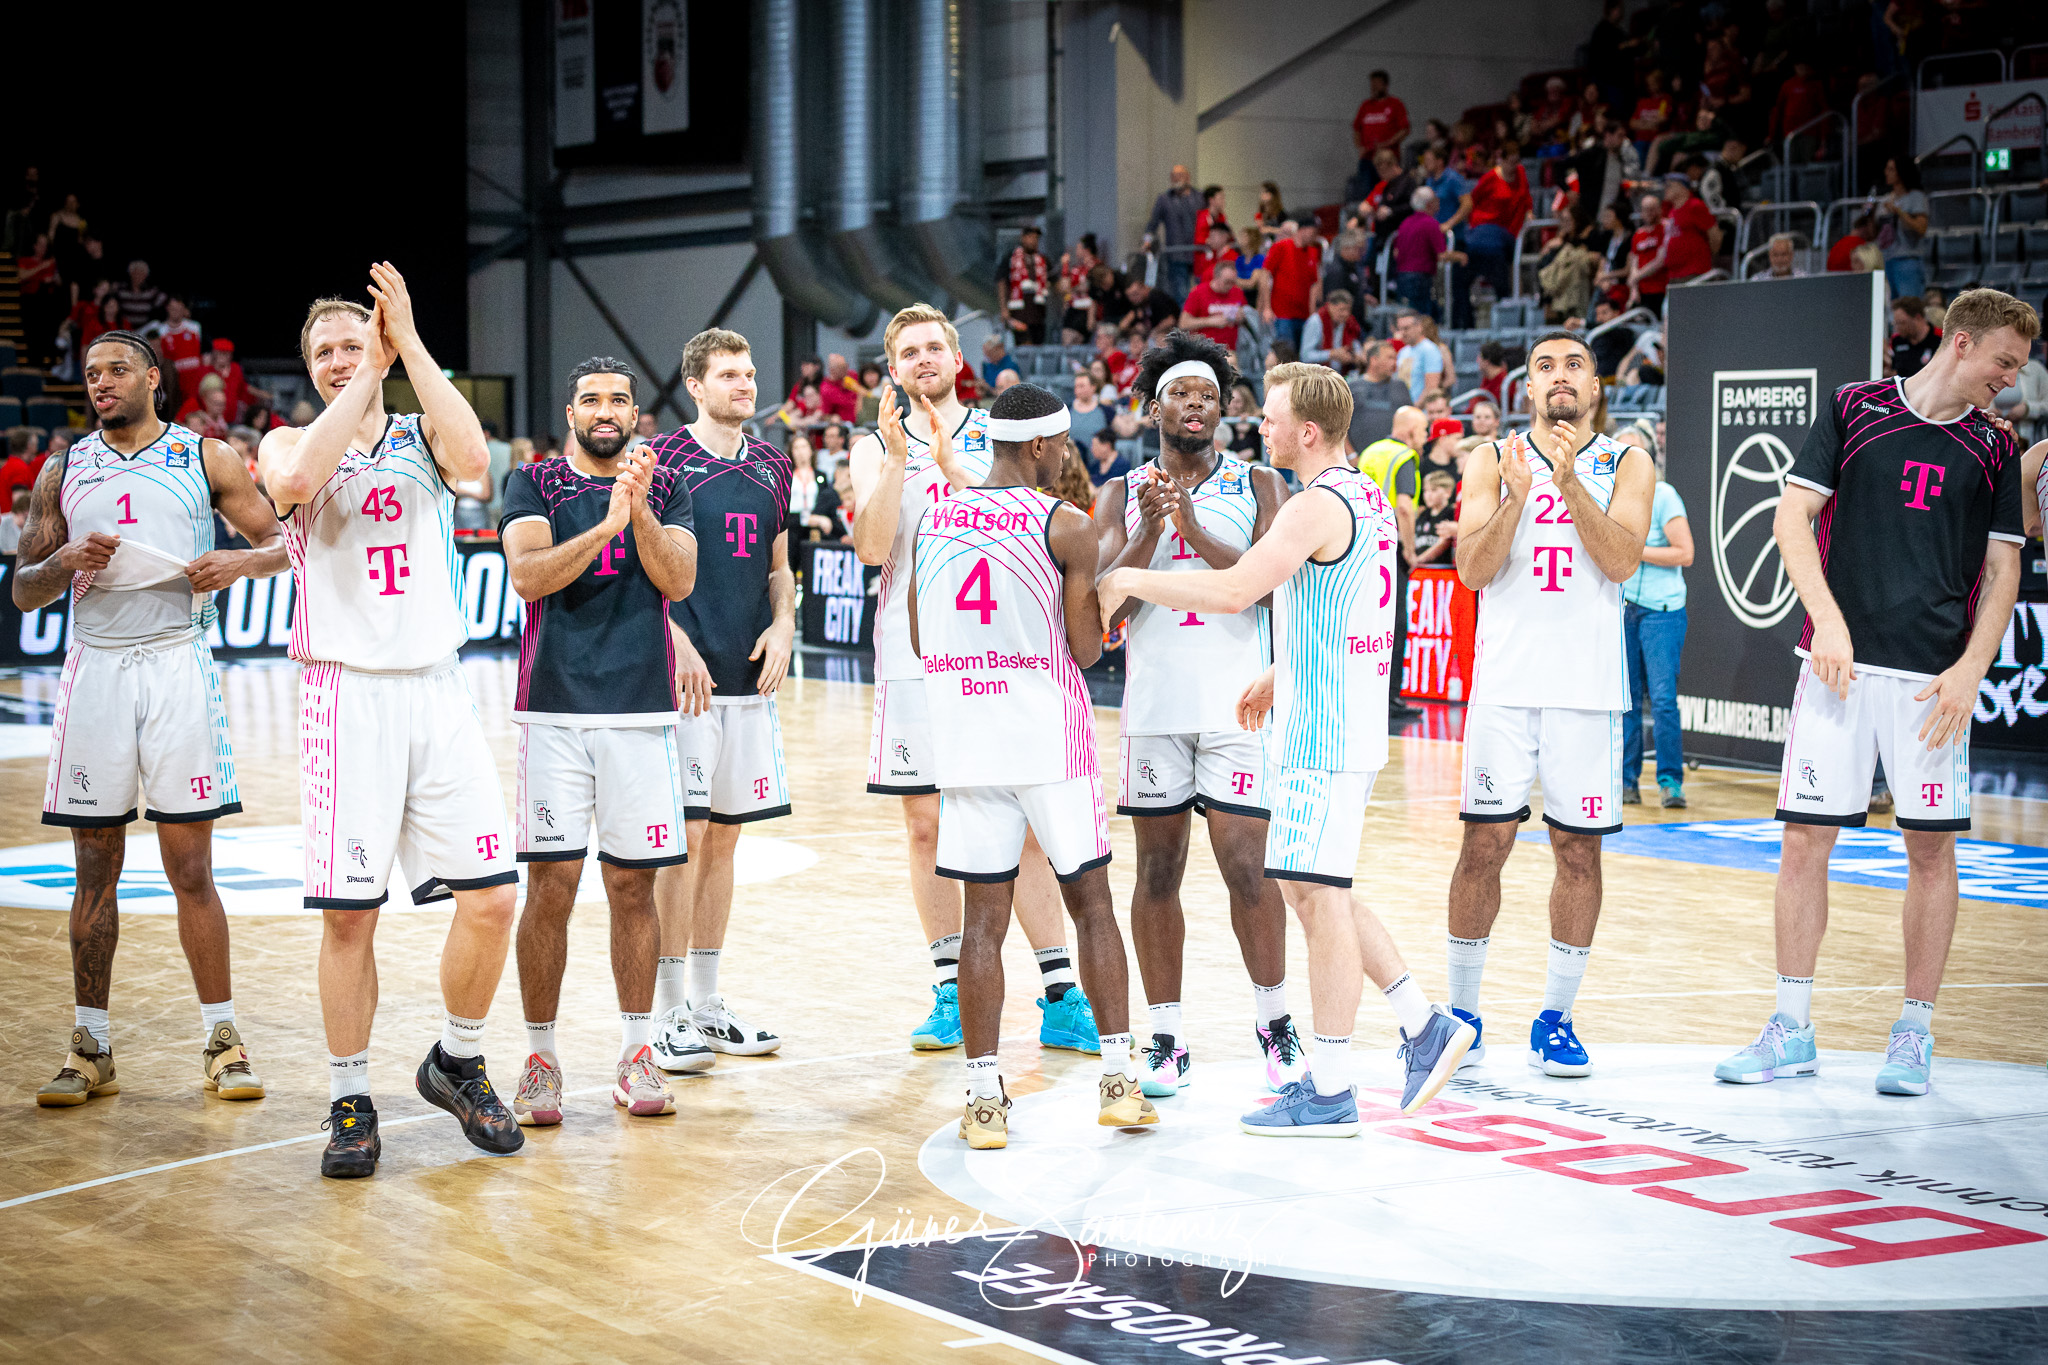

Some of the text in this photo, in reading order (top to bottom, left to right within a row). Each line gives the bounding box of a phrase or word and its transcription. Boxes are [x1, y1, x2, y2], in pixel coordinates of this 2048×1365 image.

[1722, 385, 1807, 409] BAMBERG
[1861, 401, 1890, 415] SPALDING
[1721, 409, 1807, 426] BASKETS
[683, 464, 708, 474] SPALDING
[77, 475, 105, 487] SPALDING
[116, 493, 138, 525] 1
[361, 485, 403, 522] 43
[933, 503, 1028, 533] Watson
[813, 548, 865, 597] FREAK
[955, 557, 998, 625] 4
[824, 595, 865, 644] CITY
[922, 650, 1050, 674] Telekom Baskets
[961, 677, 1009, 696] Bonn
[891, 769, 918, 778] SPALDING
[68, 797, 97, 806] SPALDING
[1137, 791, 1167, 801] SPALDING
[1474, 798, 1502, 807] SPALDING
[1796, 792, 1824, 804] SPALDING
[535, 834, 566, 843] SPALDING
[346, 875, 375, 884] SPALDING
[1447, 1077, 2048, 1215] chnik für Automobile
